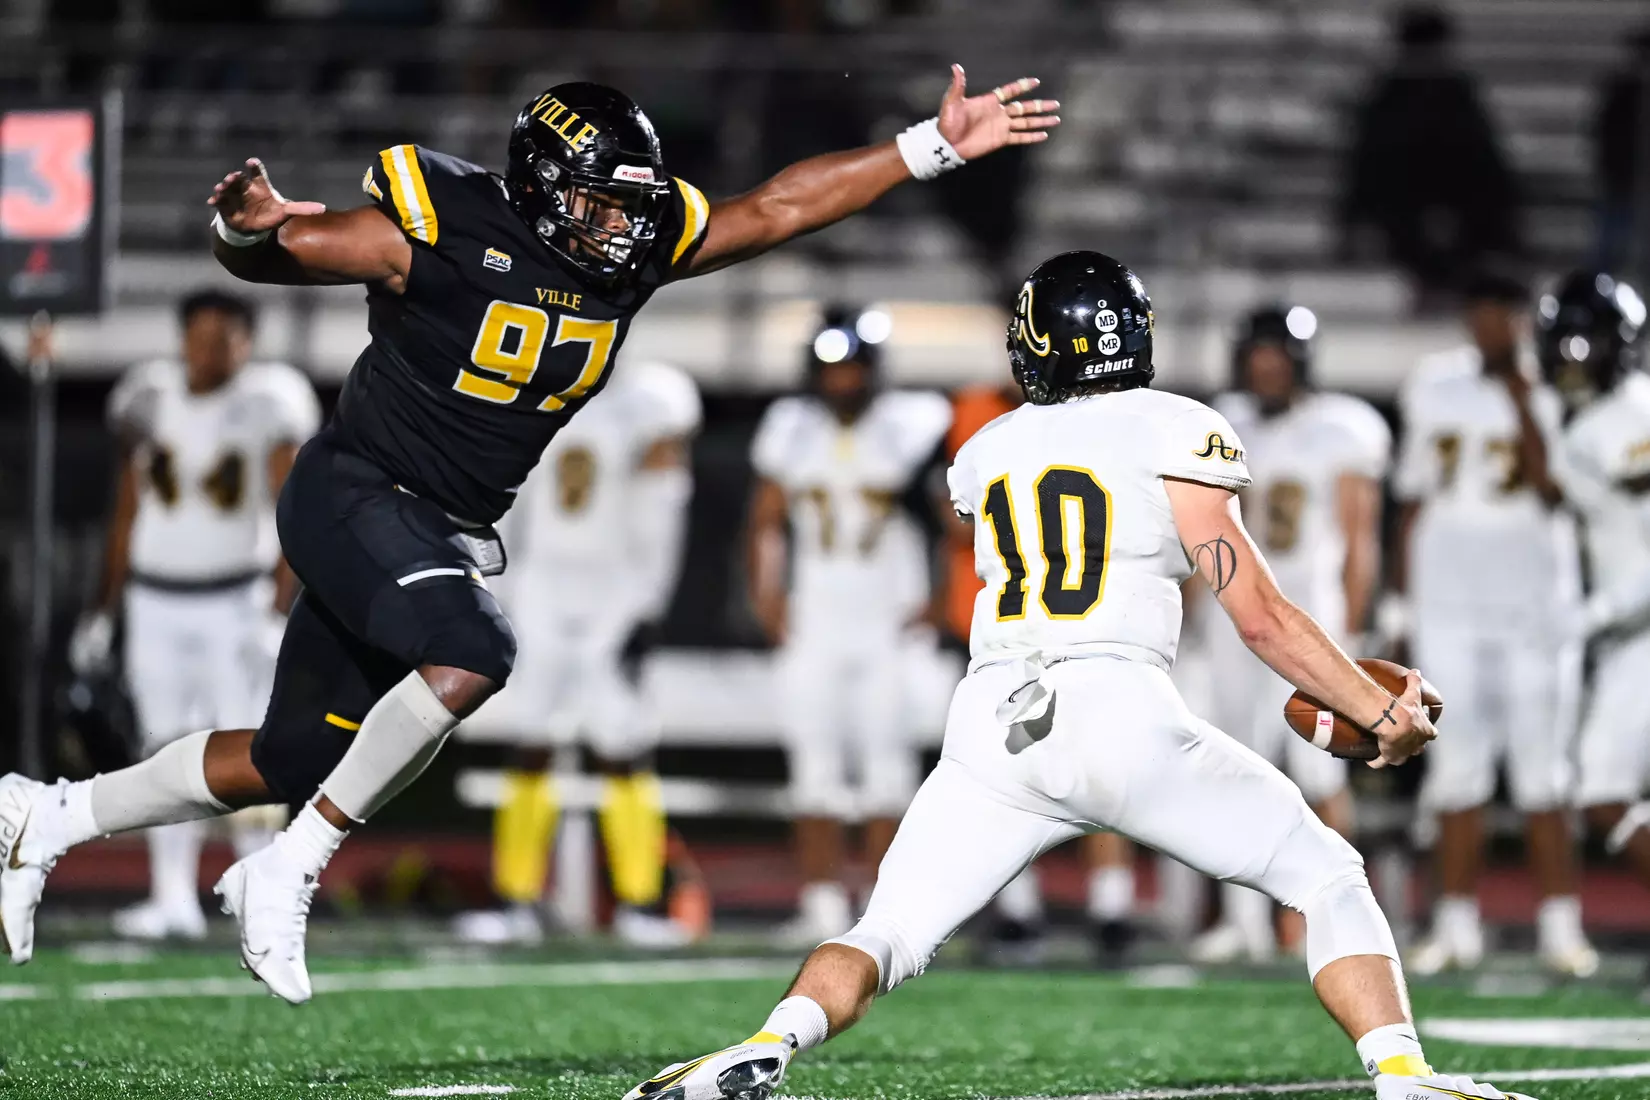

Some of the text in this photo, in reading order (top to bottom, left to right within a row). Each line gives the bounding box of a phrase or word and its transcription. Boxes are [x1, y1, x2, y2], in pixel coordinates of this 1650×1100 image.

[531, 93, 600, 153] VILLE
[0, 110, 94, 240] 3
[486, 254, 510, 267] PSAC
[535, 287, 582, 311] VILLE
[1099, 315, 1116, 328] MB
[452, 299, 619, 412] 97
[1071, 336, 1089, 355] 10
[1101, 338, 1118, 350] MR
[980, 464, 1113, 622] 10
